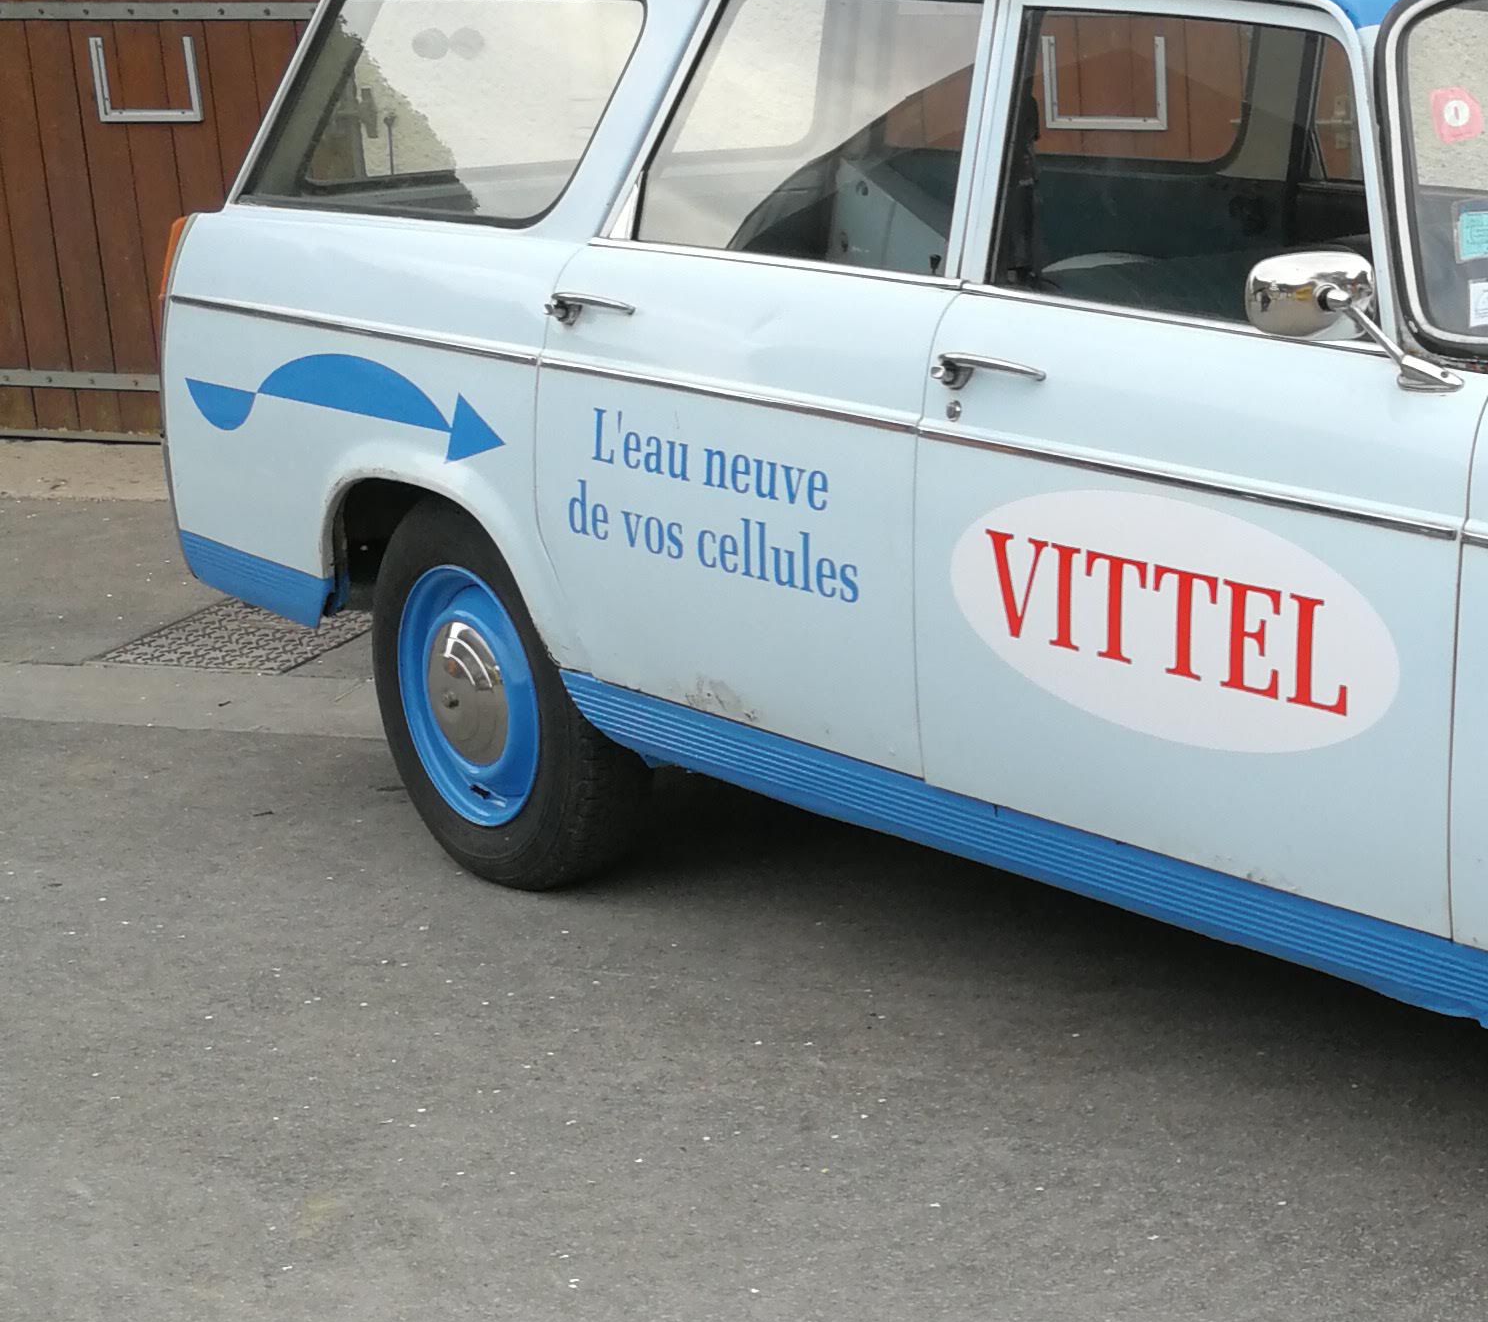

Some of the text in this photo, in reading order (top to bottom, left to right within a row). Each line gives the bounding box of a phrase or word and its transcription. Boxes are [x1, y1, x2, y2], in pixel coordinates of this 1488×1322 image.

[591, 408, 830, 512] L'eau neuve
[567, 479, 860, 604] de vos cellules
[985, 527, 1348, 717] VITTEL
